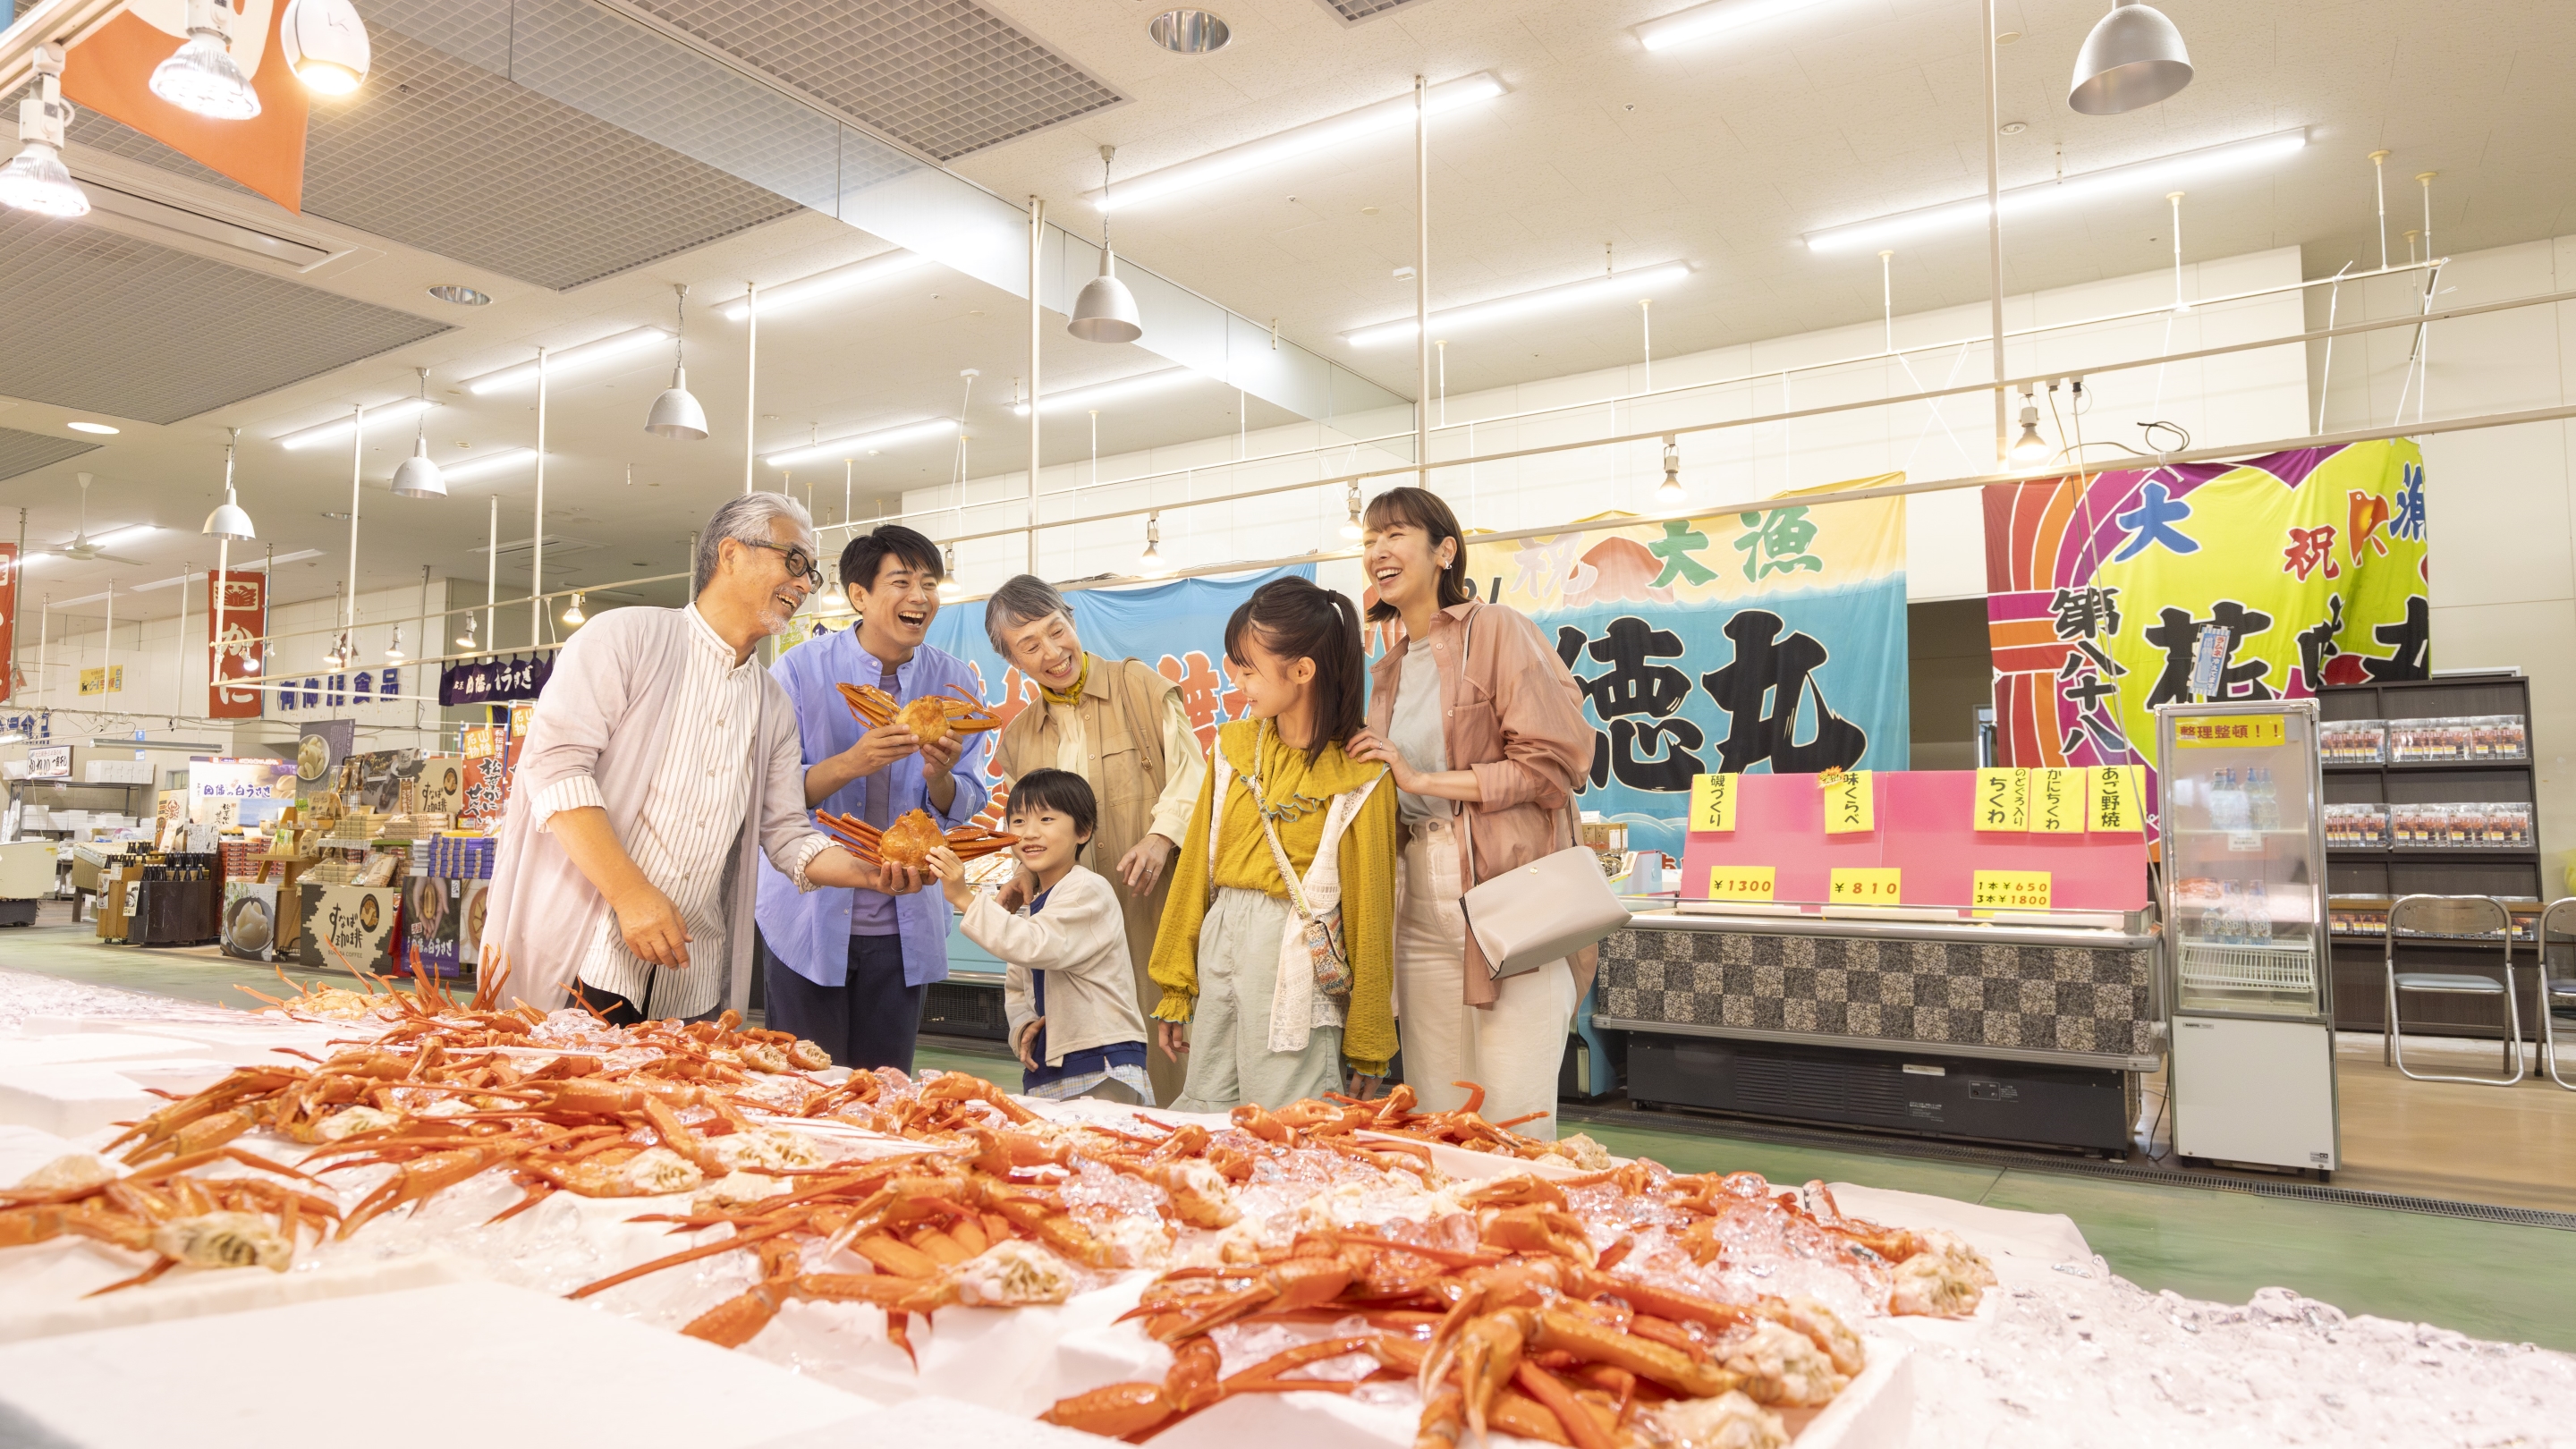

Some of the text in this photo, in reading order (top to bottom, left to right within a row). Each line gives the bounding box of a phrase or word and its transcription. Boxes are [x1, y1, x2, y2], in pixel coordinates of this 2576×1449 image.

[1647, 504, 1824, 589] 大漁
[221, 622, 255, 705] かに
[2052, 586, 2130, 756] 第八十八
[2213, 635, 2226, 657] ラムネ
[467, 733, 479, 758] 名物
[479, 729, 492, 756] 山陰
[1709, 775, 1724, 826] 磯づくり
[1843, 773, 1860, 824] 味くらべ
[1987, 776, 2007, 824] ちくわ
[2013, 768, 2026, 826] のどぐろ入り
[2046, 769, 2062, 830] かにちくわ
[2102, 767, 2120, 827] あご野焼
[346, 951, 363, 959] COFFEE
